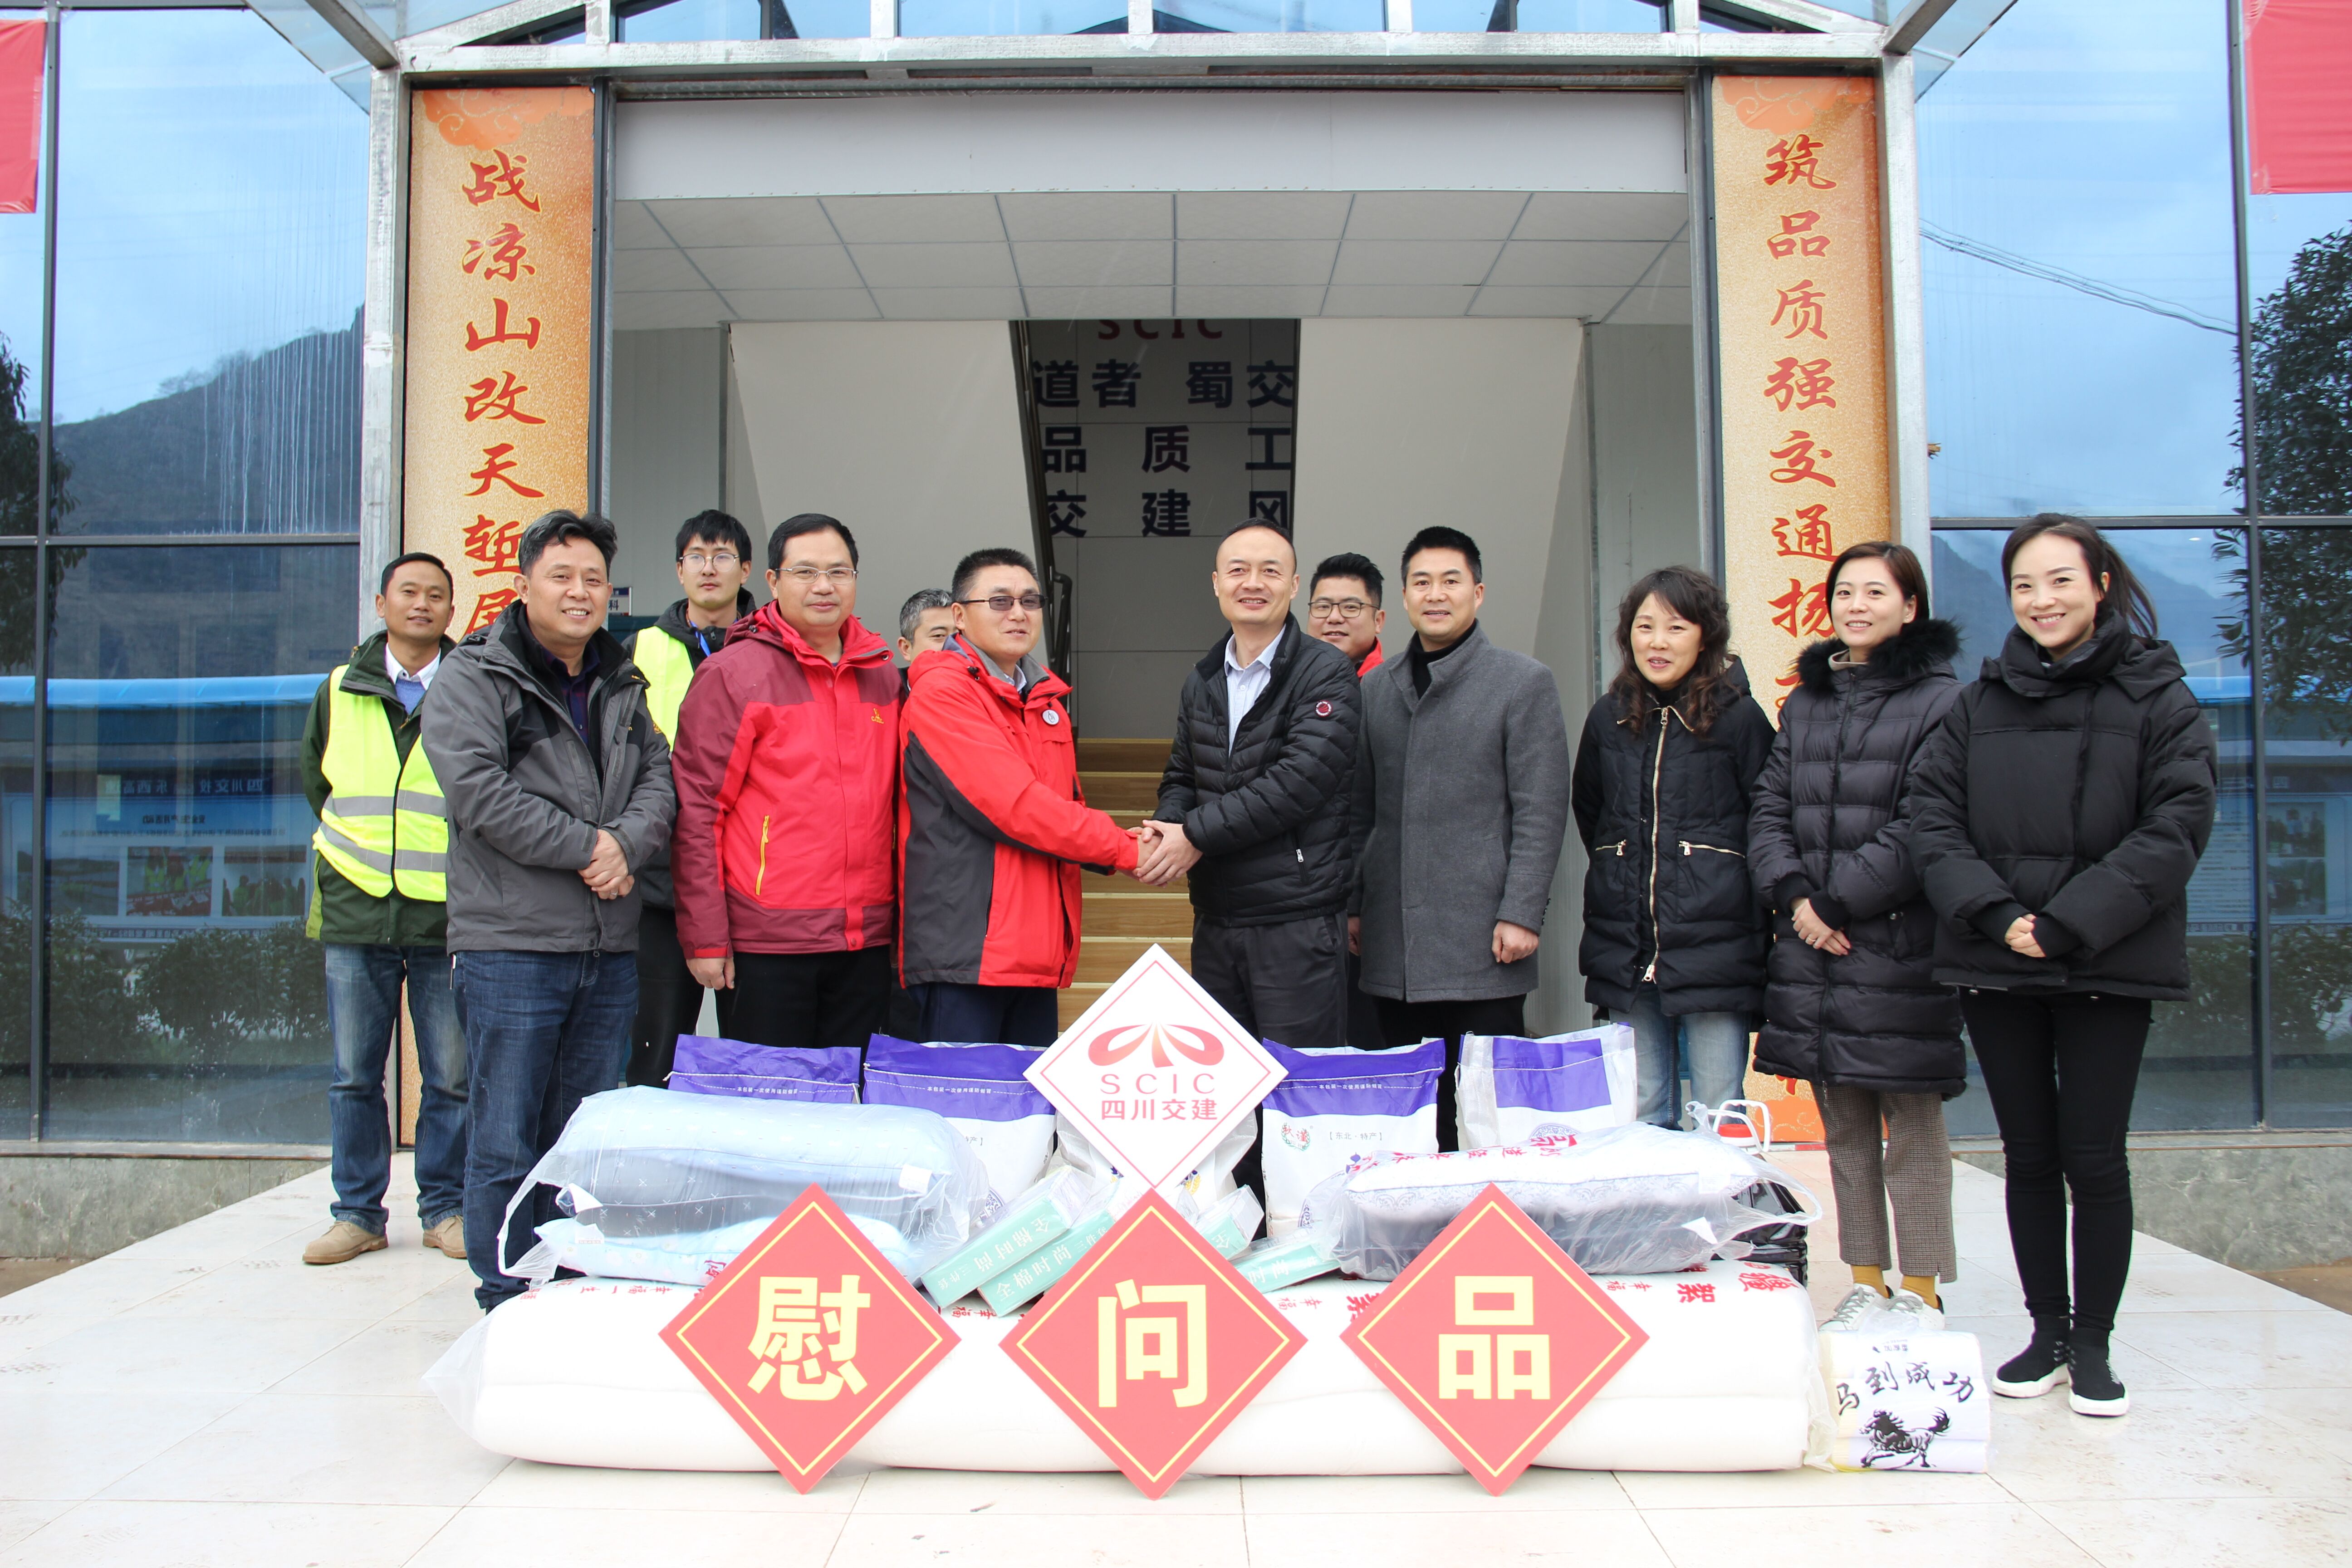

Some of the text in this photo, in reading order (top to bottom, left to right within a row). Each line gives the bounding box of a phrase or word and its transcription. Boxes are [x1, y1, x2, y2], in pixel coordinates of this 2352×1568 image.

[1765, 134, 1836, 709] 筑品质强交通扬
[1100, 1073, 1215, 1094] SCIC
[1102, 1099, 1218, 1121] 四川交建
[937, 1214, 1051, 1290] 全棉时尚 三件套
[996, 1244, 1073, 1301] 全棉时尚
[747, 1274, 871, 1401] 慰
[1098, 1279, 1207, 1407] 问
[1438, 1276, 1550, 1399] 品
[1836, 1362, 1975, 1416] 马到成功
